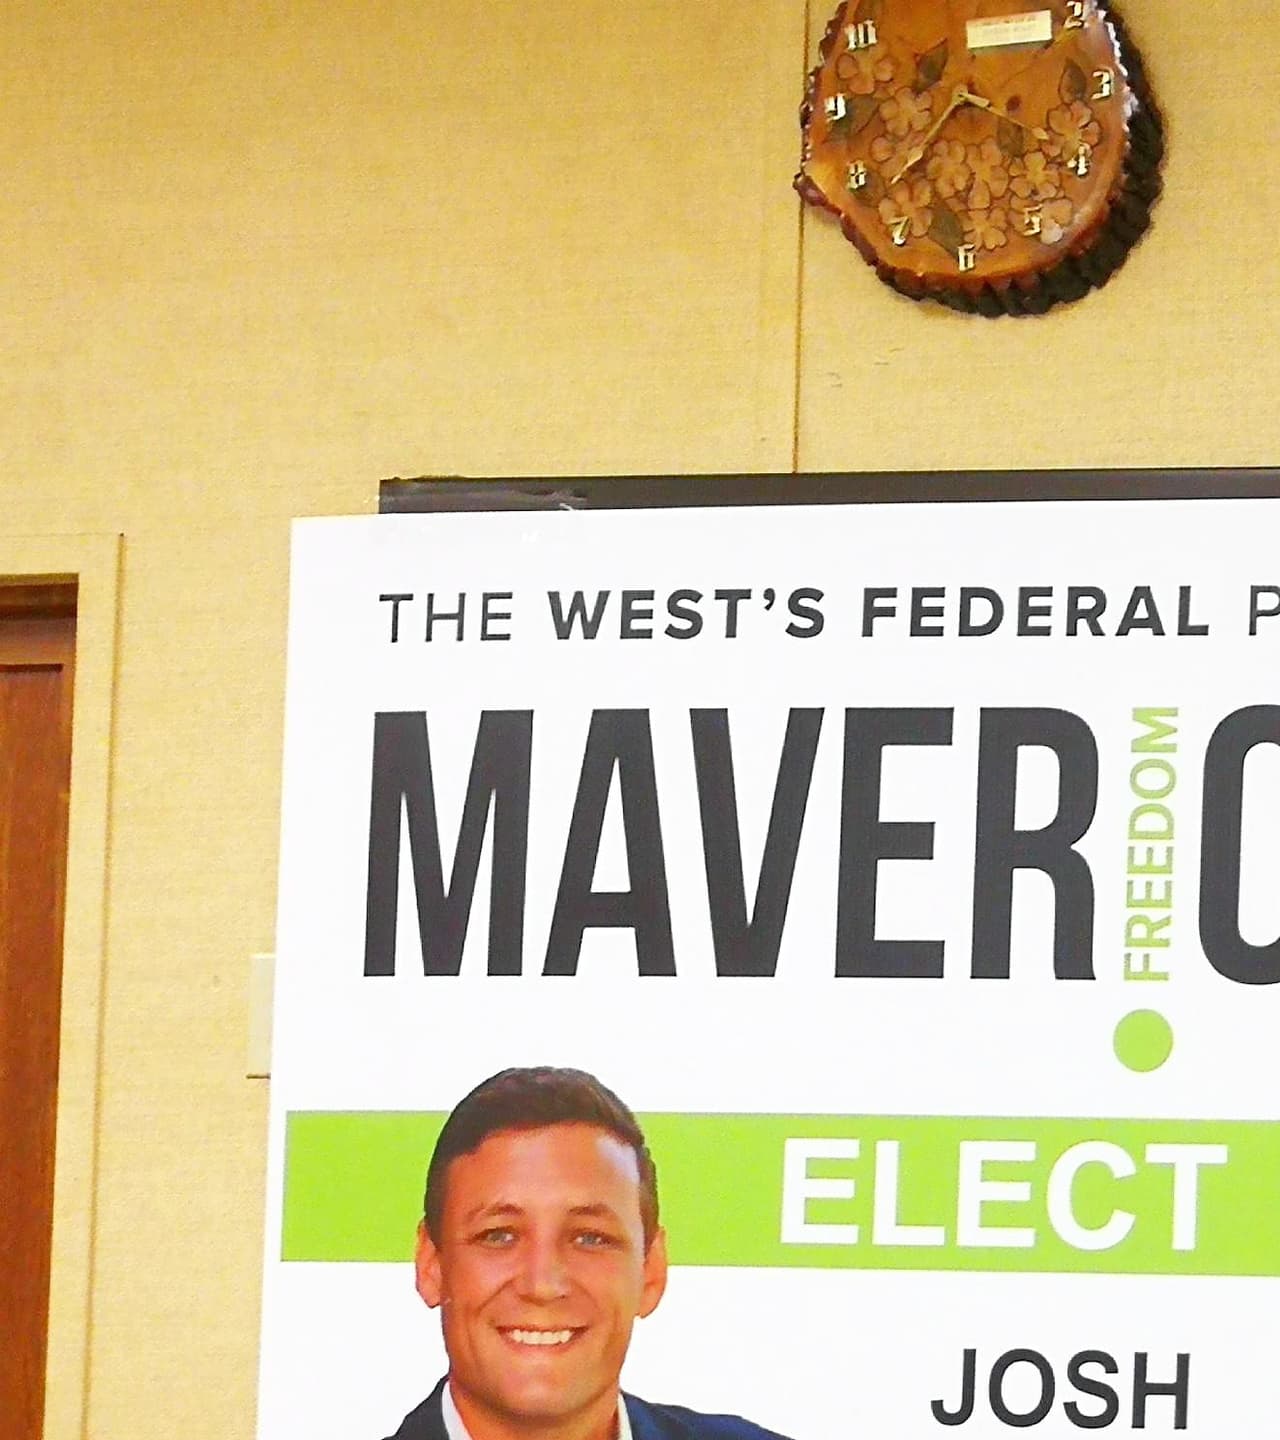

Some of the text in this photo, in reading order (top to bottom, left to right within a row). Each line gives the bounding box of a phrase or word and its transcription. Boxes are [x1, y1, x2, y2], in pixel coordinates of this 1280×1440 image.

[1091, 70, 1112, 99] 3
[380, 593, 513, 644] THE
[549, 589, 825, 641] WEST'S
[863, 587, 1209, 638] FEDERAL
[1126, 710, 1177, 981] FREEDOM
[783, 1140, 1228, 1251] ELECT
[932, 1350, 1190, 1430] JOSH
